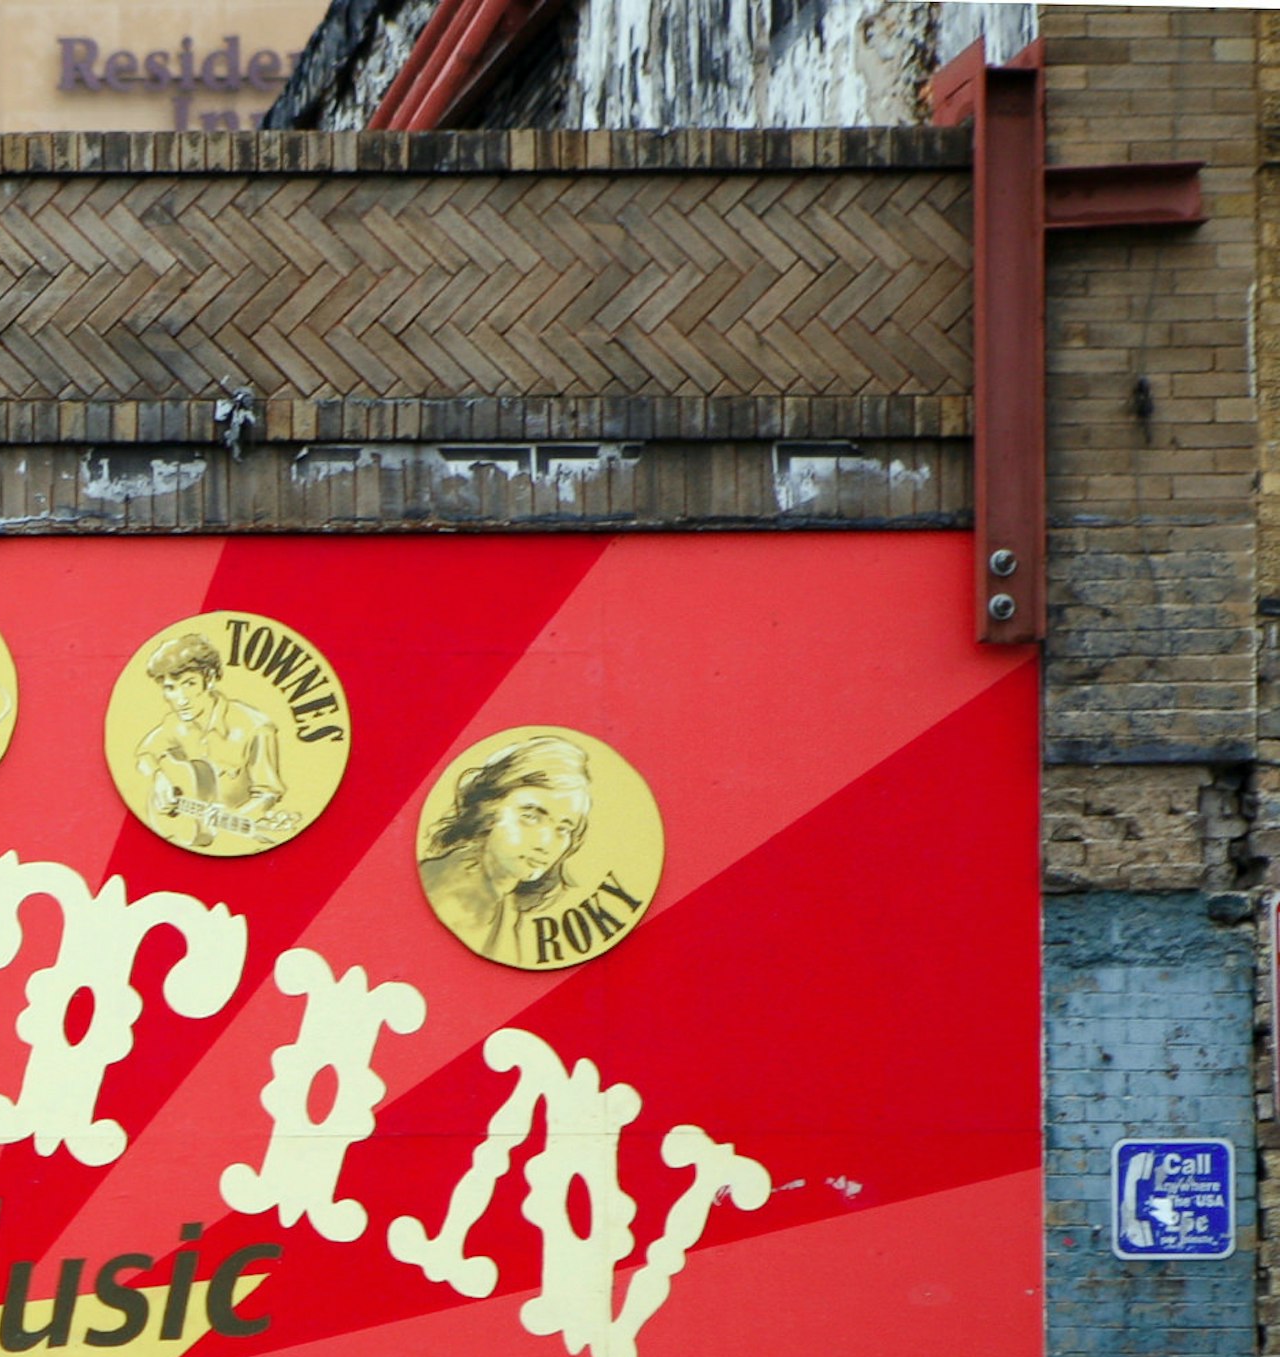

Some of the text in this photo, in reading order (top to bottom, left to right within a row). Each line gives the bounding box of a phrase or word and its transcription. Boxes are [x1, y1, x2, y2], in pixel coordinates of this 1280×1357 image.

[57, 36, 305, 92] Reside
[226, 619, 344, 745] TOWNES
[533, 871, 643, 965] ROKY
[1162, 1153, 1212, 1175] Call
[1196, 1194, 1225, 1208] USA
